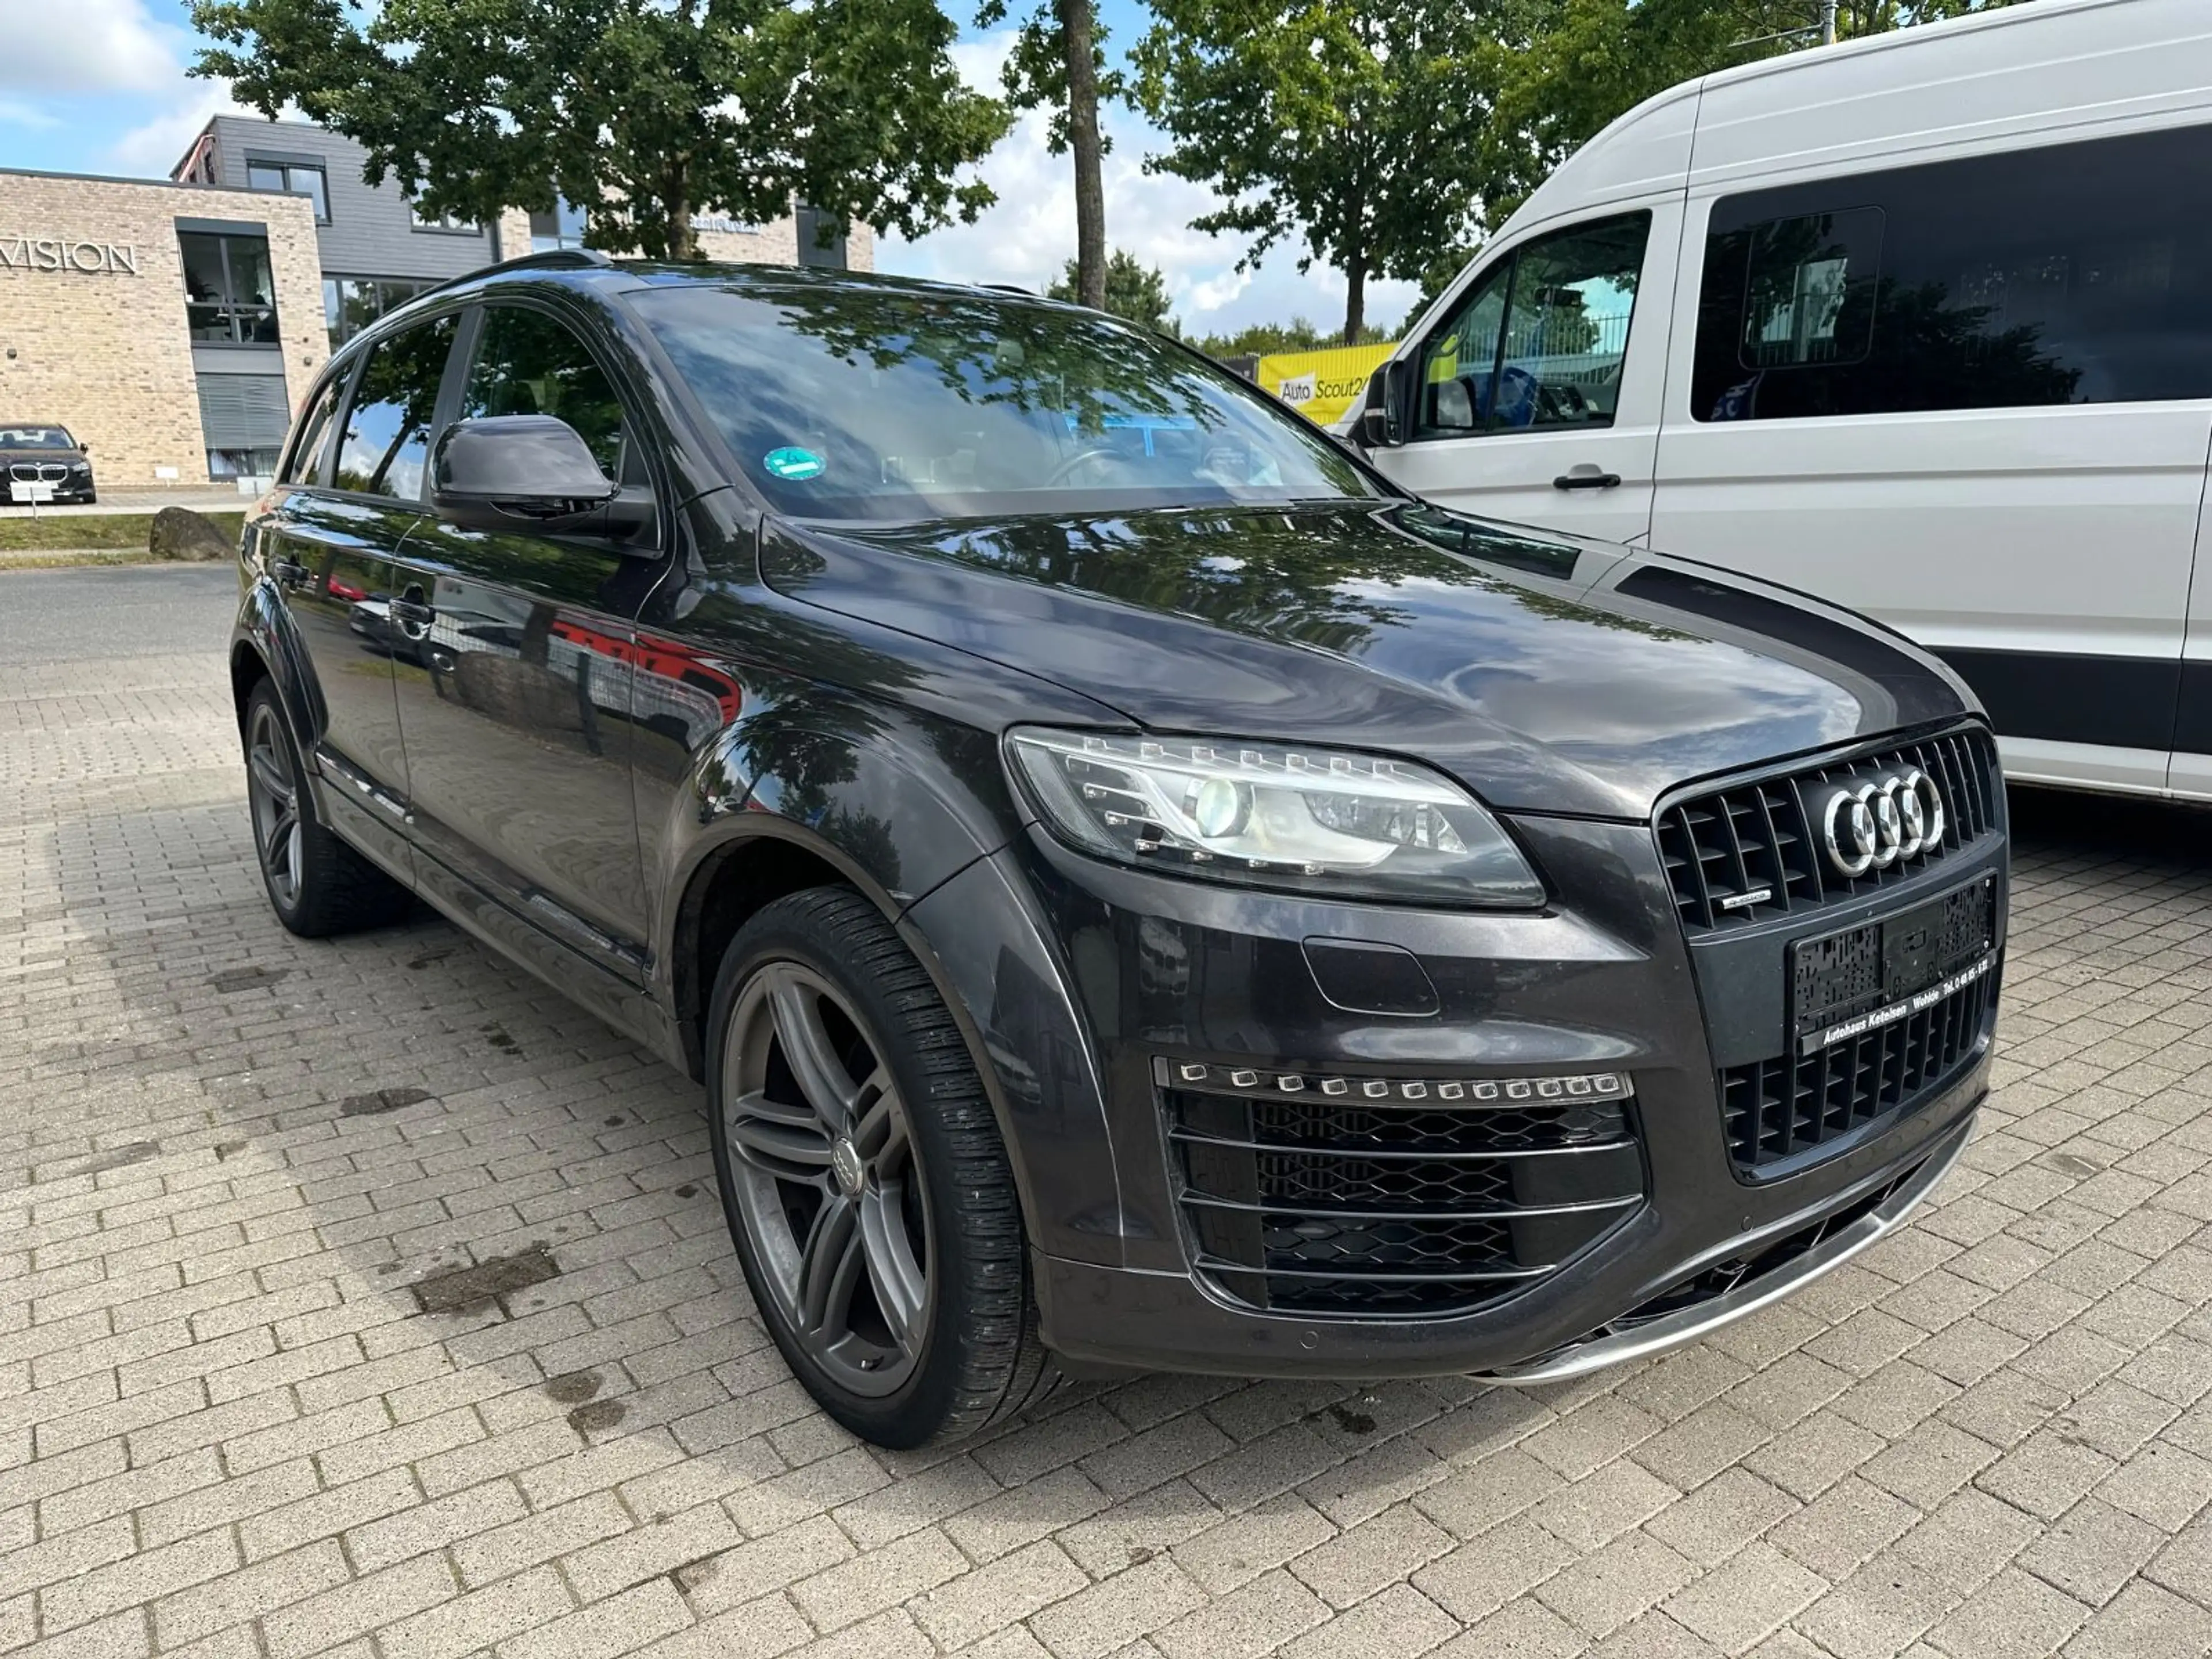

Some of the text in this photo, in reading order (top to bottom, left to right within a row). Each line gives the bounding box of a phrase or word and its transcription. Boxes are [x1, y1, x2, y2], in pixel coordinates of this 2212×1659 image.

[0, 238, 138, 274] VISION
[1282, 381, 1310, 401] Auto
[1823, 1020, 1868, 1045] Autohaus
